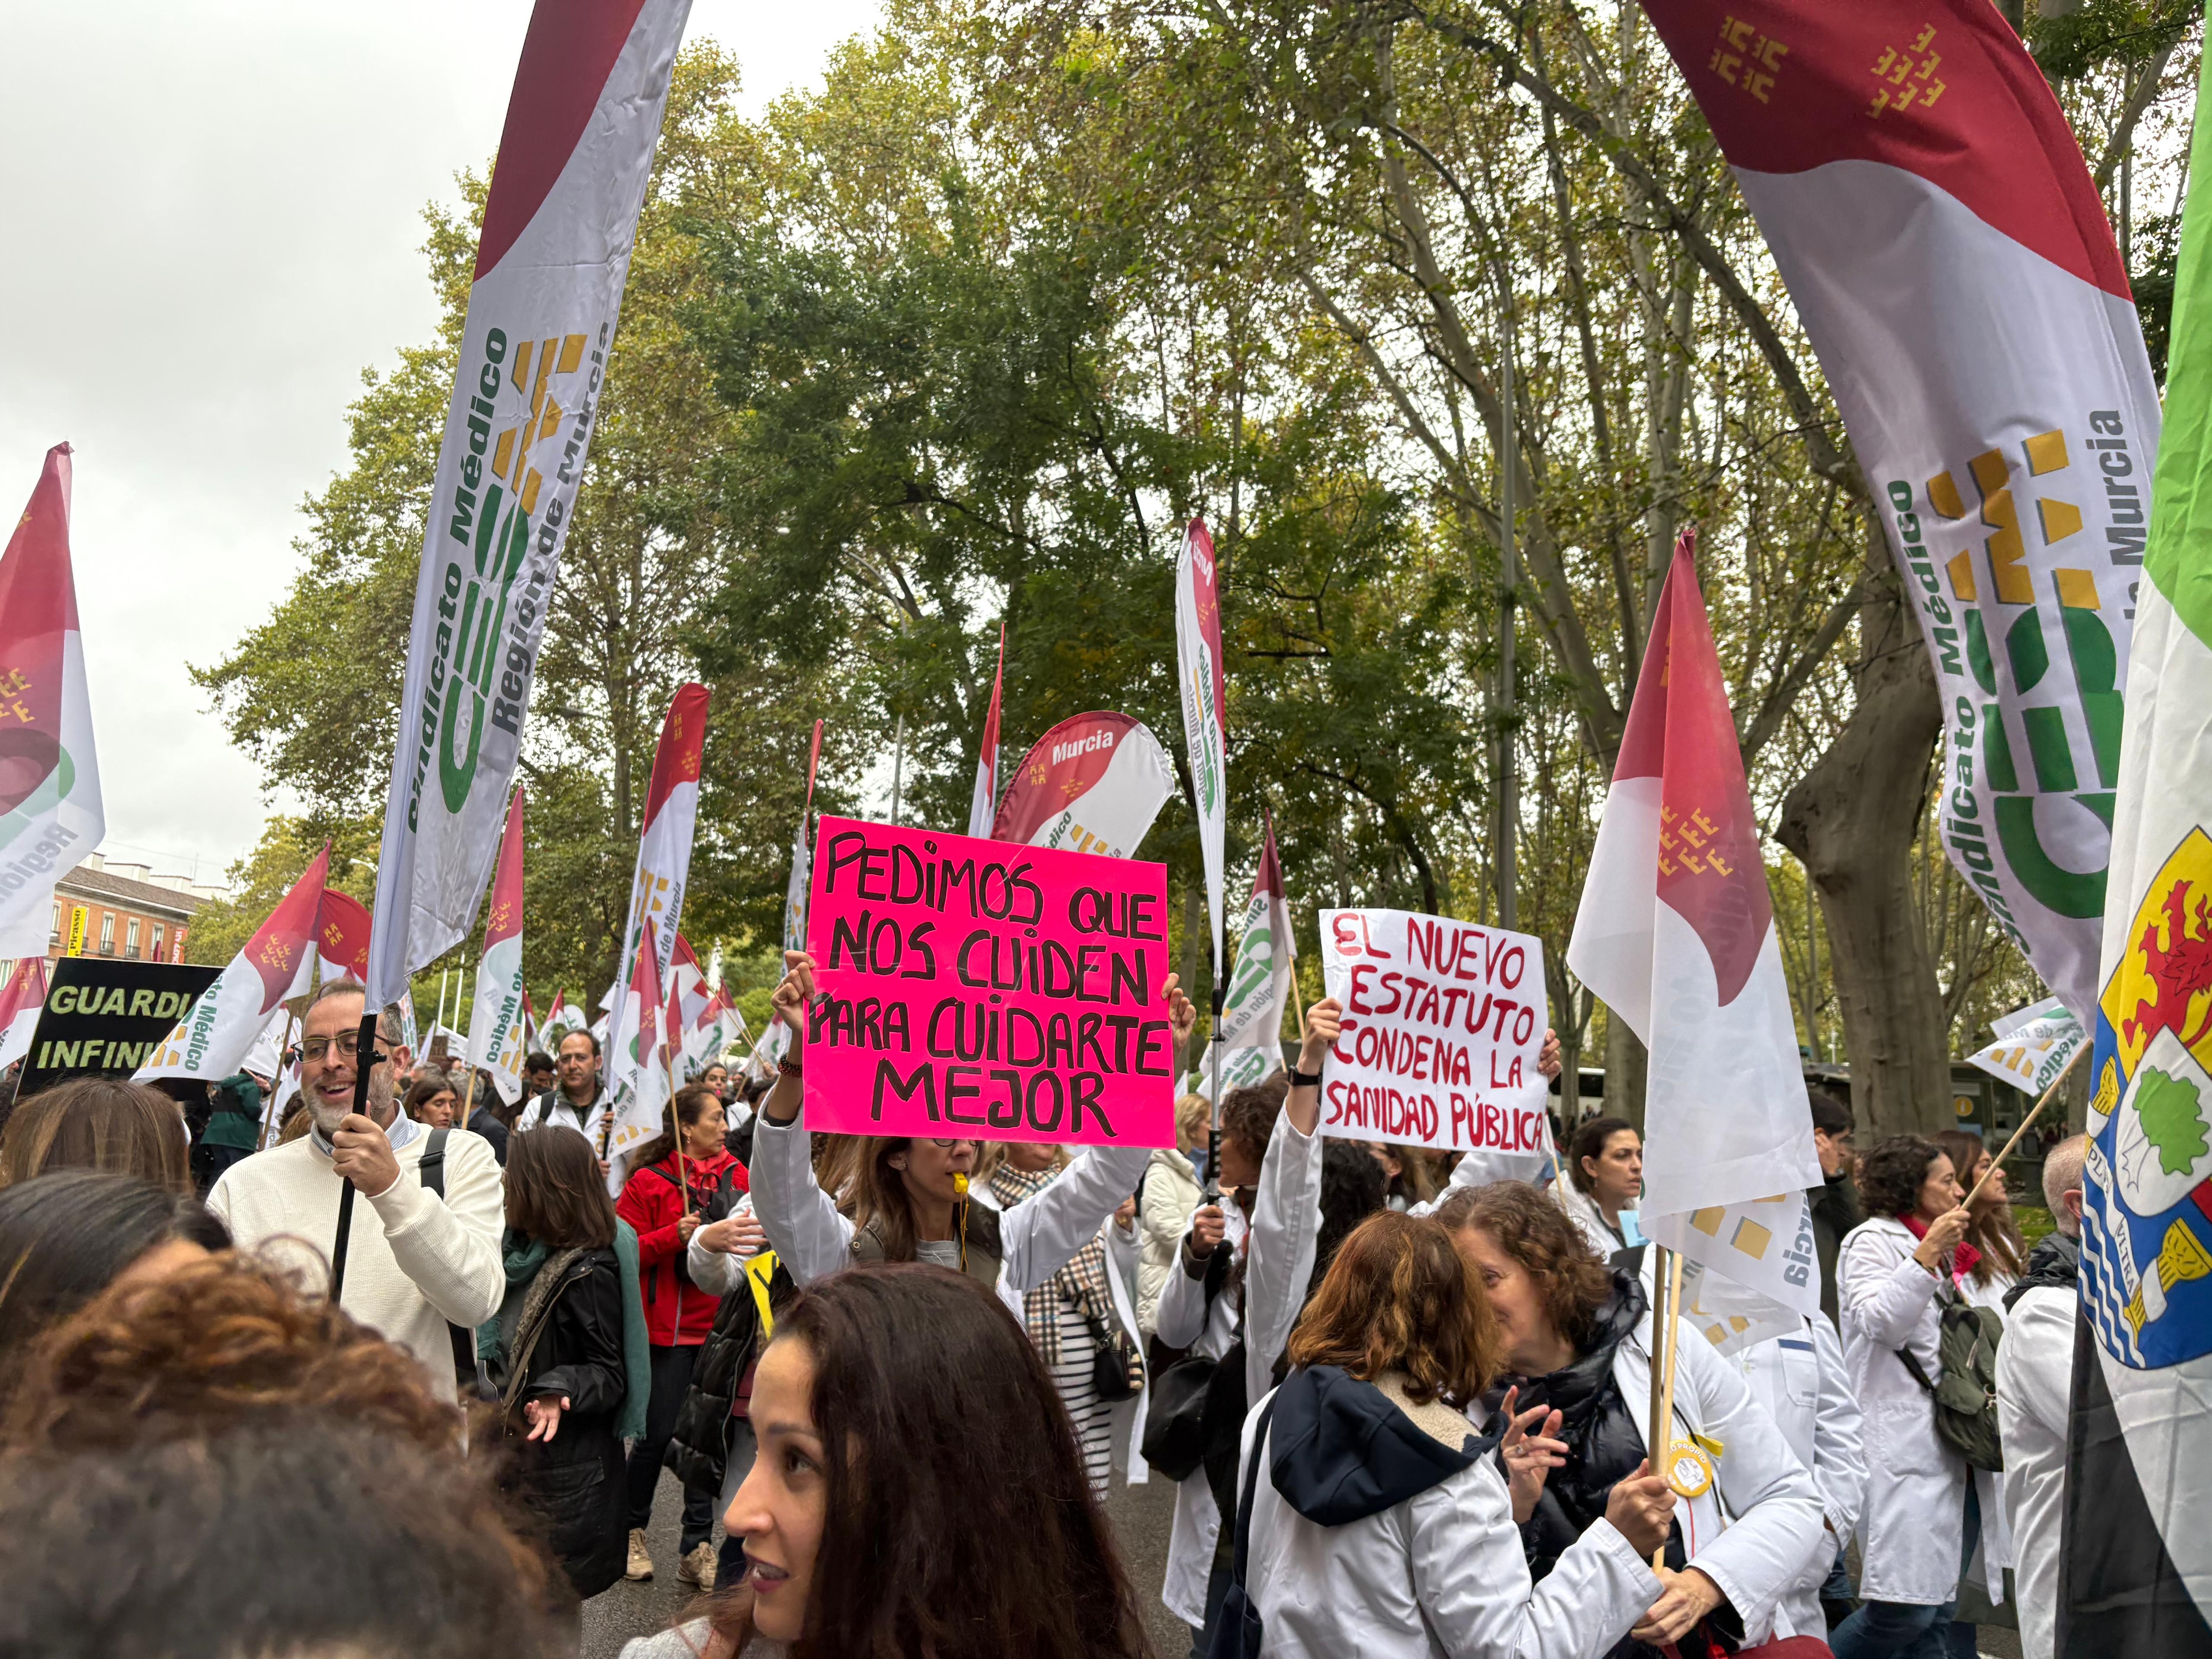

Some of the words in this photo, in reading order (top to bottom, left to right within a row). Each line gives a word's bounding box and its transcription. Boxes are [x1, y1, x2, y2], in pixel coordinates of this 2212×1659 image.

[450, 327, 507, 546] Médico
[2085, 410, 2147, 566] Murcia
[492, 570, 546, 736] Región
[537, 497, 563, 556] de
[557, 322, 609, 485] Murcia
[1888, 480, 1964, 677] Médico
[1053, 730, 1113, 766] Murcia
[829, 909, 936, 980] NOS
[1068, 887, 1163, 941] QUE
[1332, 912, 1391, 959] EL
[1407, 917, 1525, 990] NUEVO
[50, 986, 191, 1019] GUARDI
[185, 1005, 217, 1071] Médico
[807, 992, 911, 1052] PARA
[1349, 964, 1534, 1046] ESTATUTO
[37, 1040, 158, 1068] INFINI
[1331, 1019, 1471, 1087] CONDENA
[1491, 1049, 1522, 1089] LA
[871, 1057, 1119, 1137] MEJOR
[1326, 1080, 1439, 1142] SANIDAD
[1450, 1092, 1542, 1152] PÚBLICA
